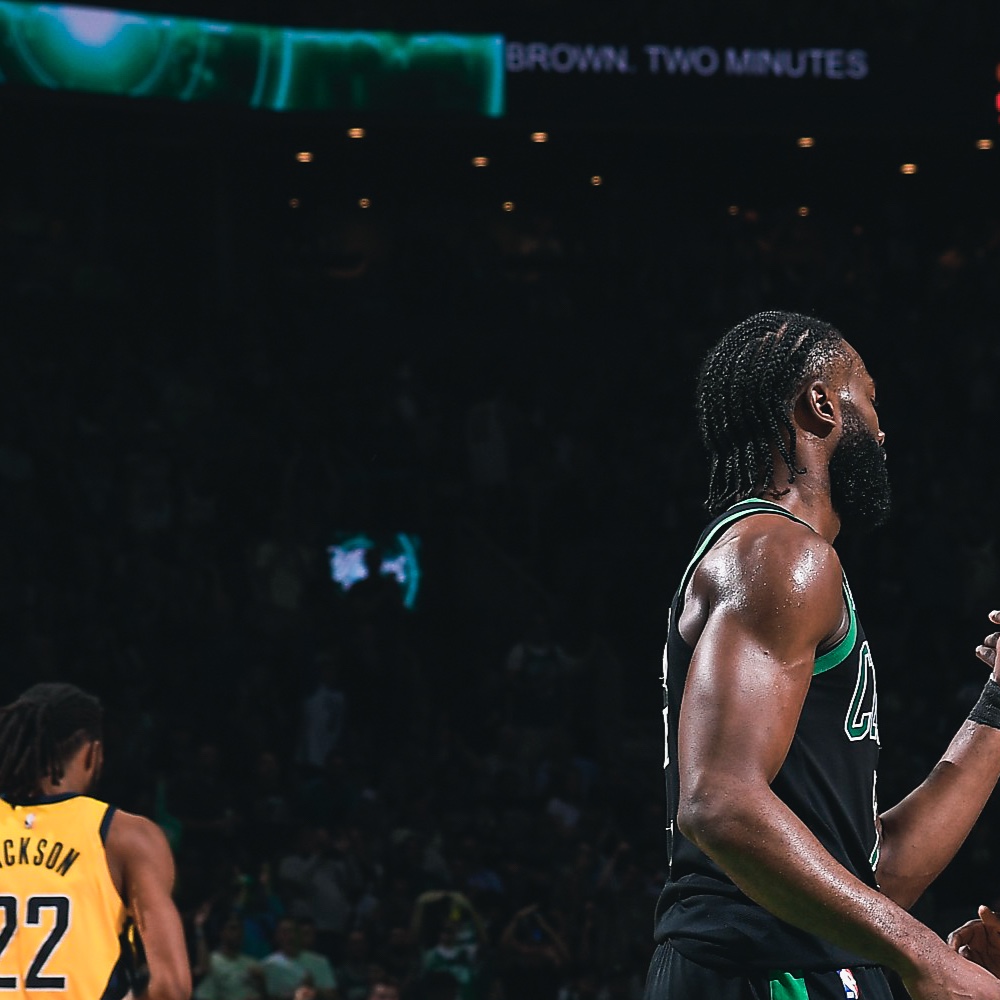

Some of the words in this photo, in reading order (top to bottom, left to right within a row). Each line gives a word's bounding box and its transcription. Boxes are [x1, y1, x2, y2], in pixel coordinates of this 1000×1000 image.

[646, 45, 719, 77] TWO
[725, 47, 868, 79] MINUTES
[0, 837, 80, 877] CKSON
